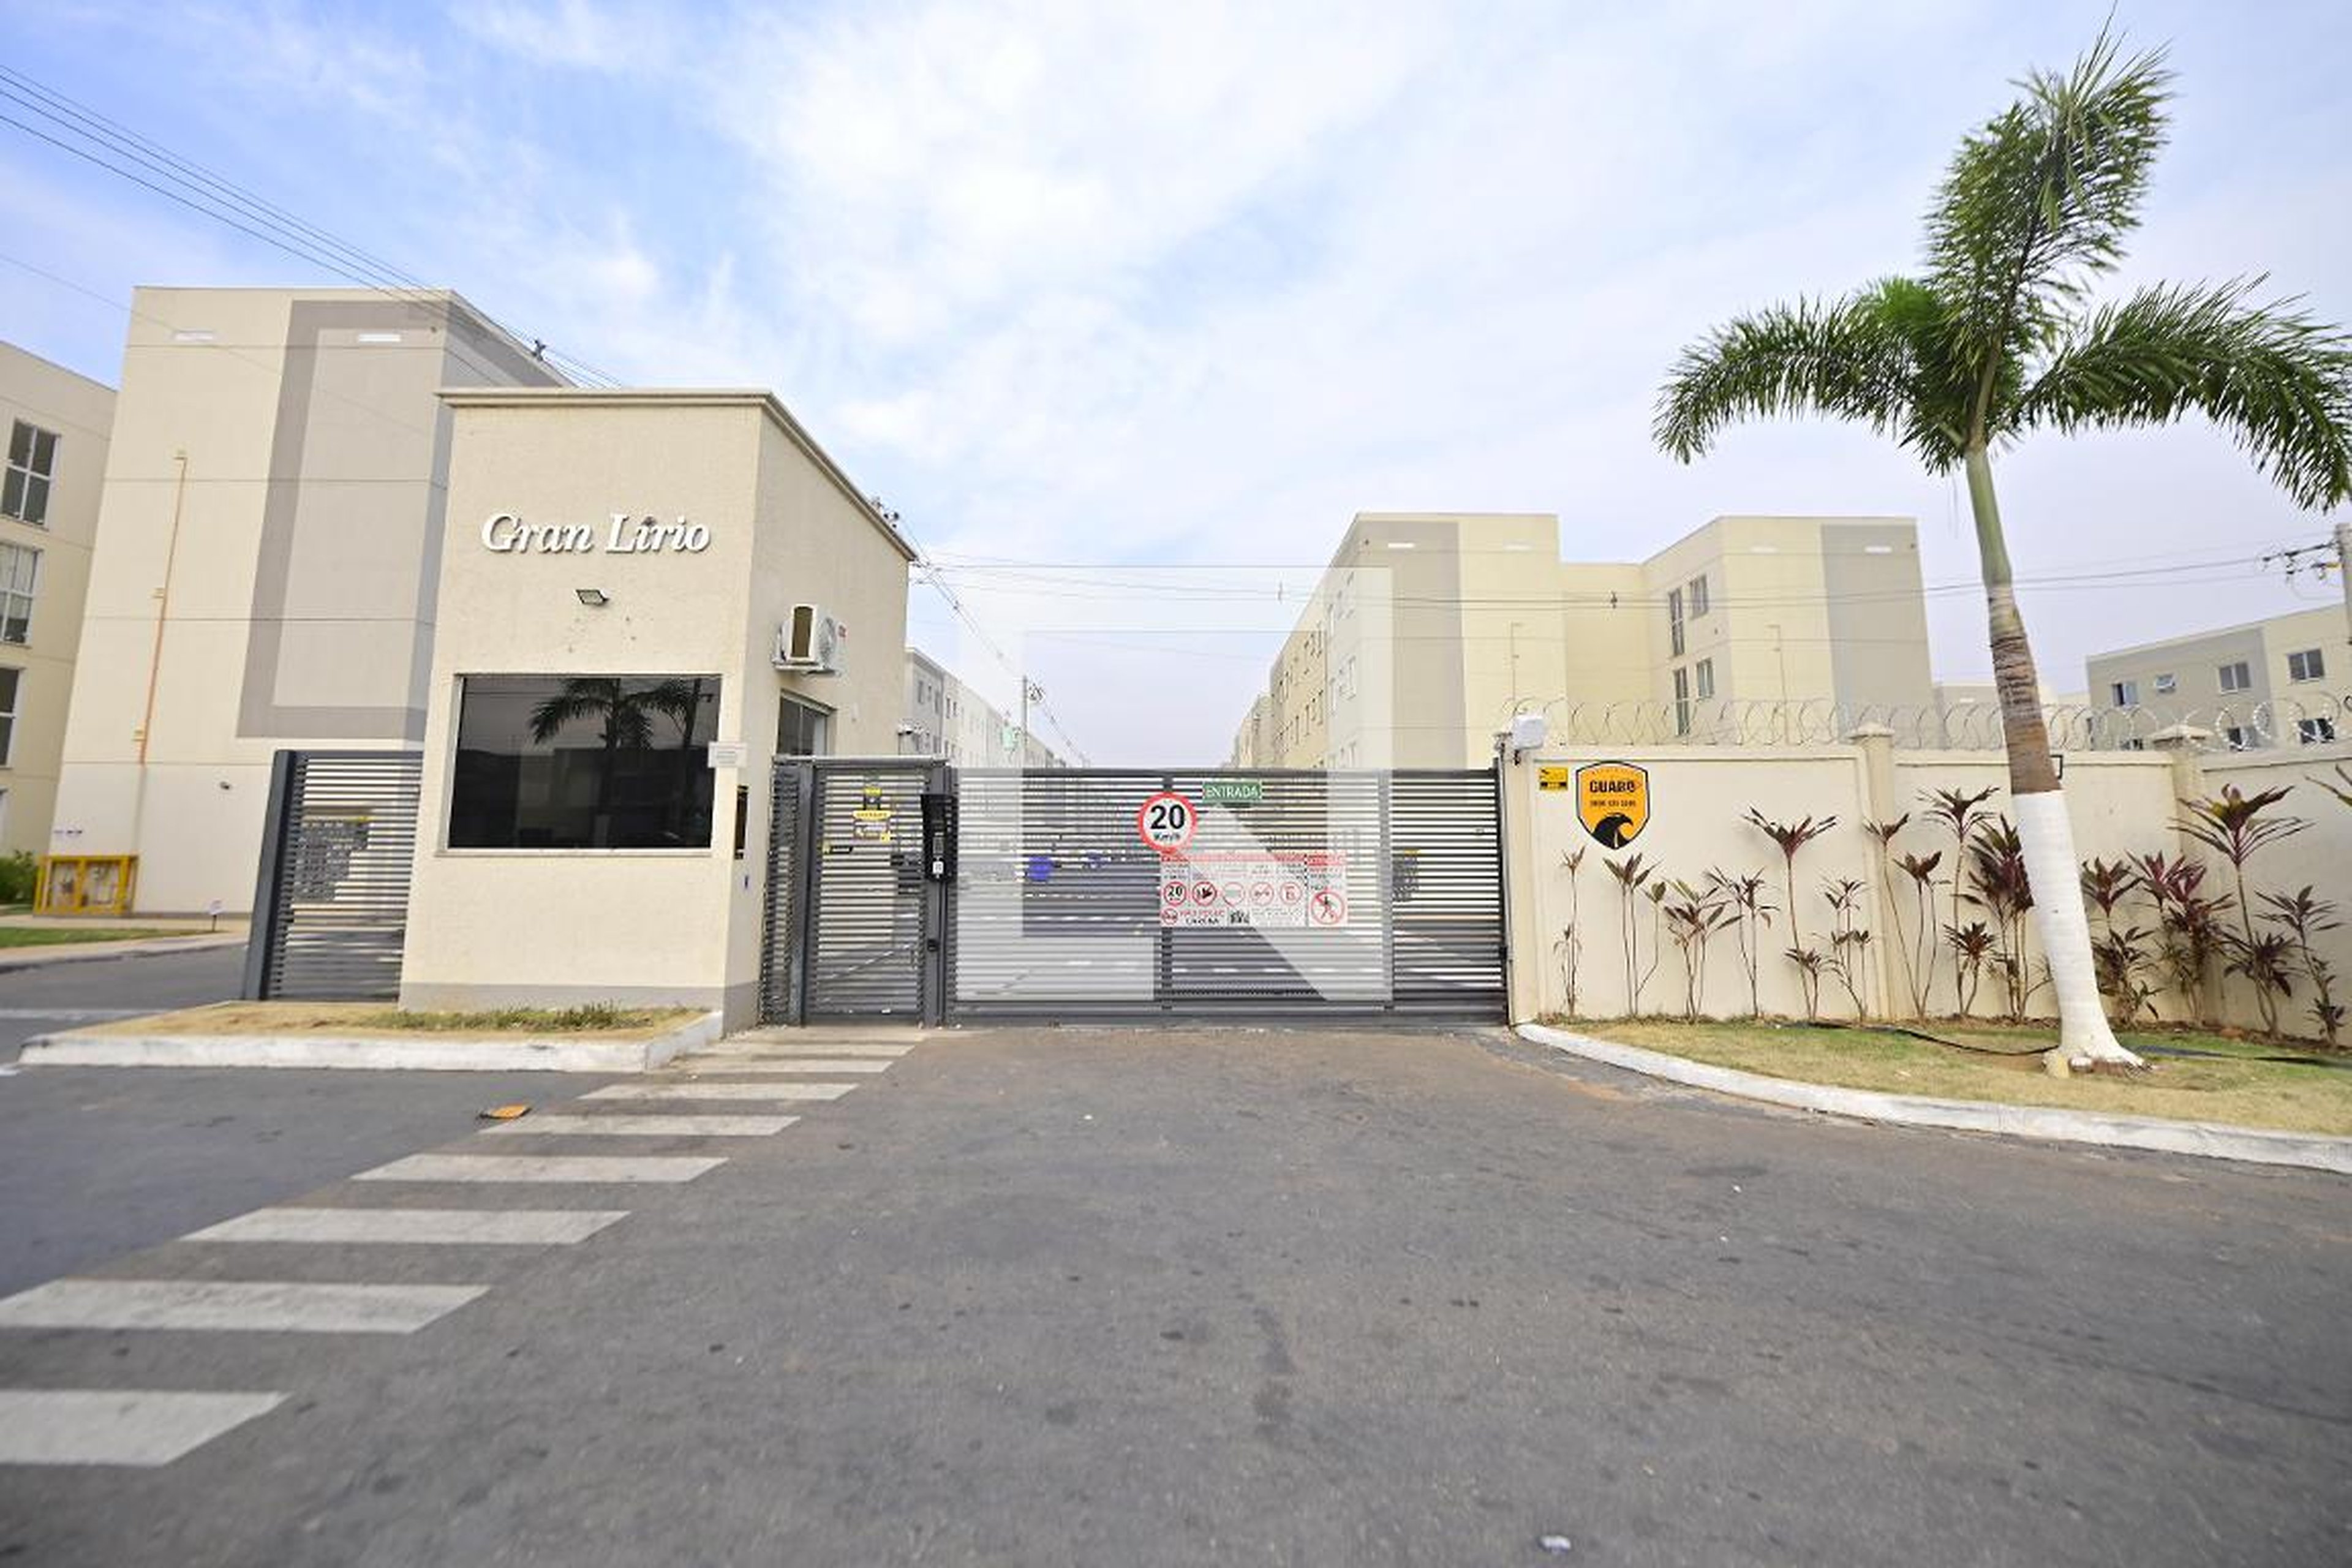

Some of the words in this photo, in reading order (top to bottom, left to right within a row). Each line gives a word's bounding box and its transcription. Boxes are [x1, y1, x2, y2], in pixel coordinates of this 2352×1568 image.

[481, 512, 594, 553] Gran
[1205, 786, 1259, 798] ENTRADA
[1150, 804, 1185, 829] 20
